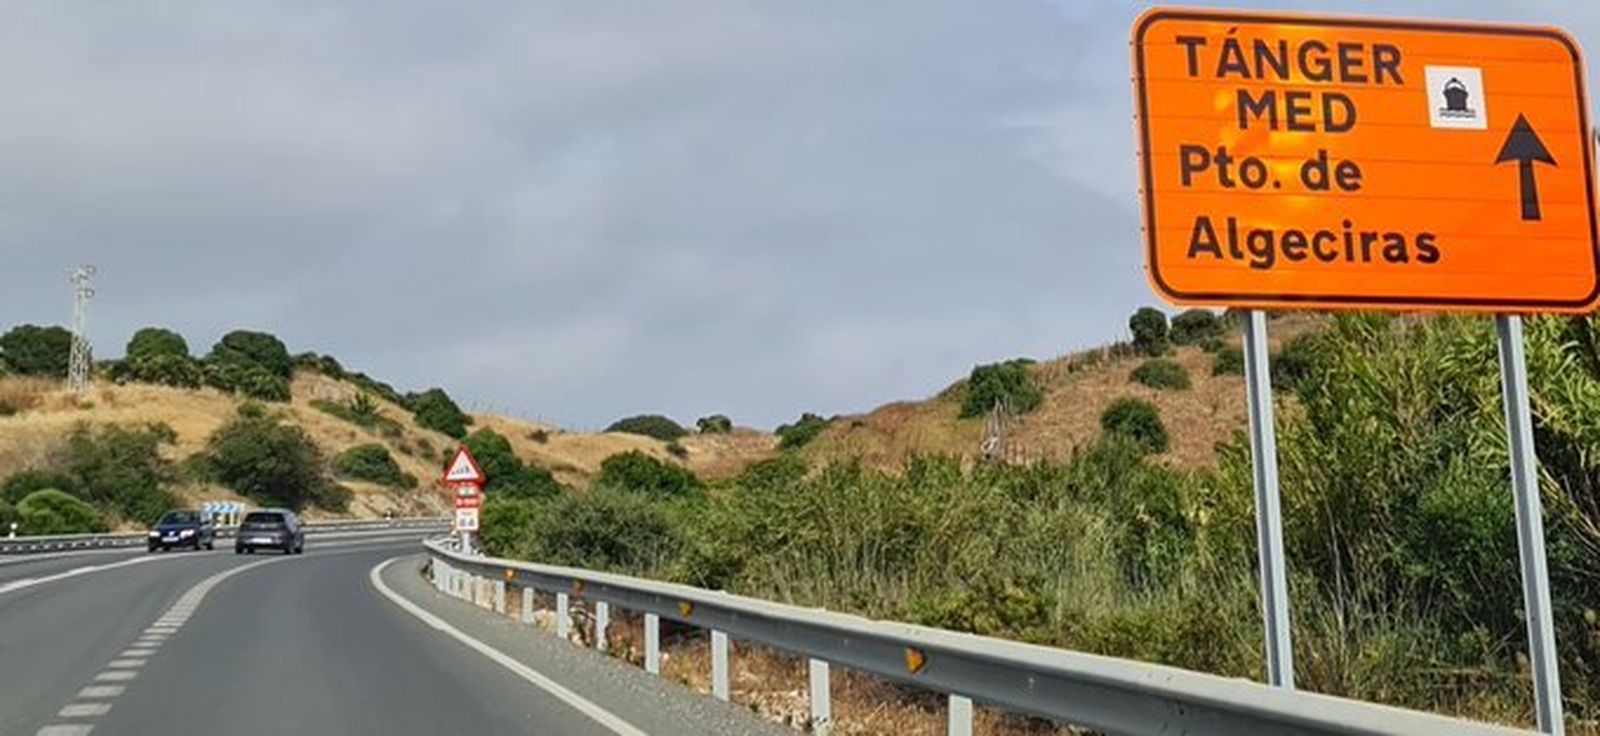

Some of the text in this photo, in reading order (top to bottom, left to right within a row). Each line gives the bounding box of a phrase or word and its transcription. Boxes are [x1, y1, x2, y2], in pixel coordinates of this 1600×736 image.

[1175, 27, 1404, 85] TÁNGER
[1236, 89, 1358, 134] MED
[1179, 144, 1363, 192] Pto. de
[1187, 216, 1441, 270] Algeciras
